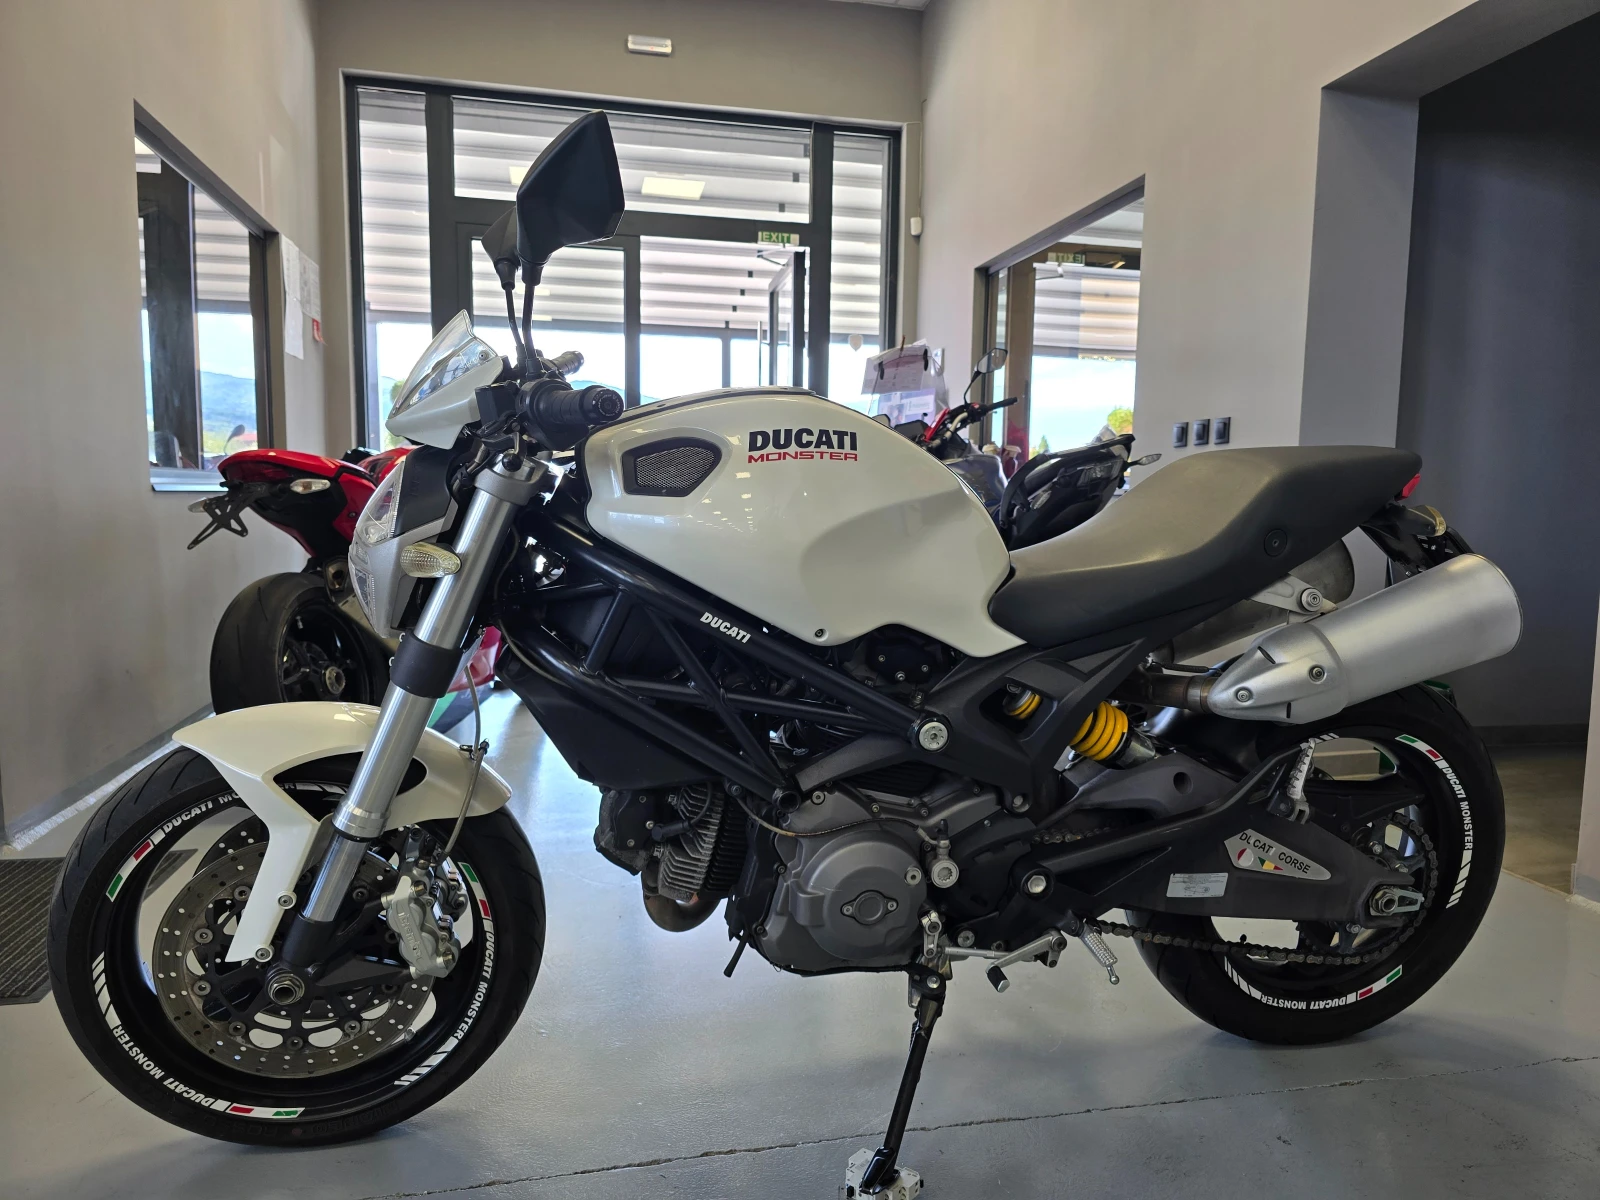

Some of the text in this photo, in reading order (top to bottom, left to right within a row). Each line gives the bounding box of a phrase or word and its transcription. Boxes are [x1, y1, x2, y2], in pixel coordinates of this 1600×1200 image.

[762, 231, 790, 243] EXIT
[748, 428, 858, 452] DUCATI
[748, 451, 858, 463] MONSTER
[700, 611, 751, 643] DUCATI
[162, 801, 213, 834] DUCATI
[1442, 767, 1473, 850] DUCATI MONSTER
[1278, 851, 1311, 874] CORSE
[453, 931, 495, 1040] DUCATI MONSTER
[1261, 994, 1347, 1010] DUCATI MONSTER
[112, 1025, 215, 1107] DUCATI MONSTER
